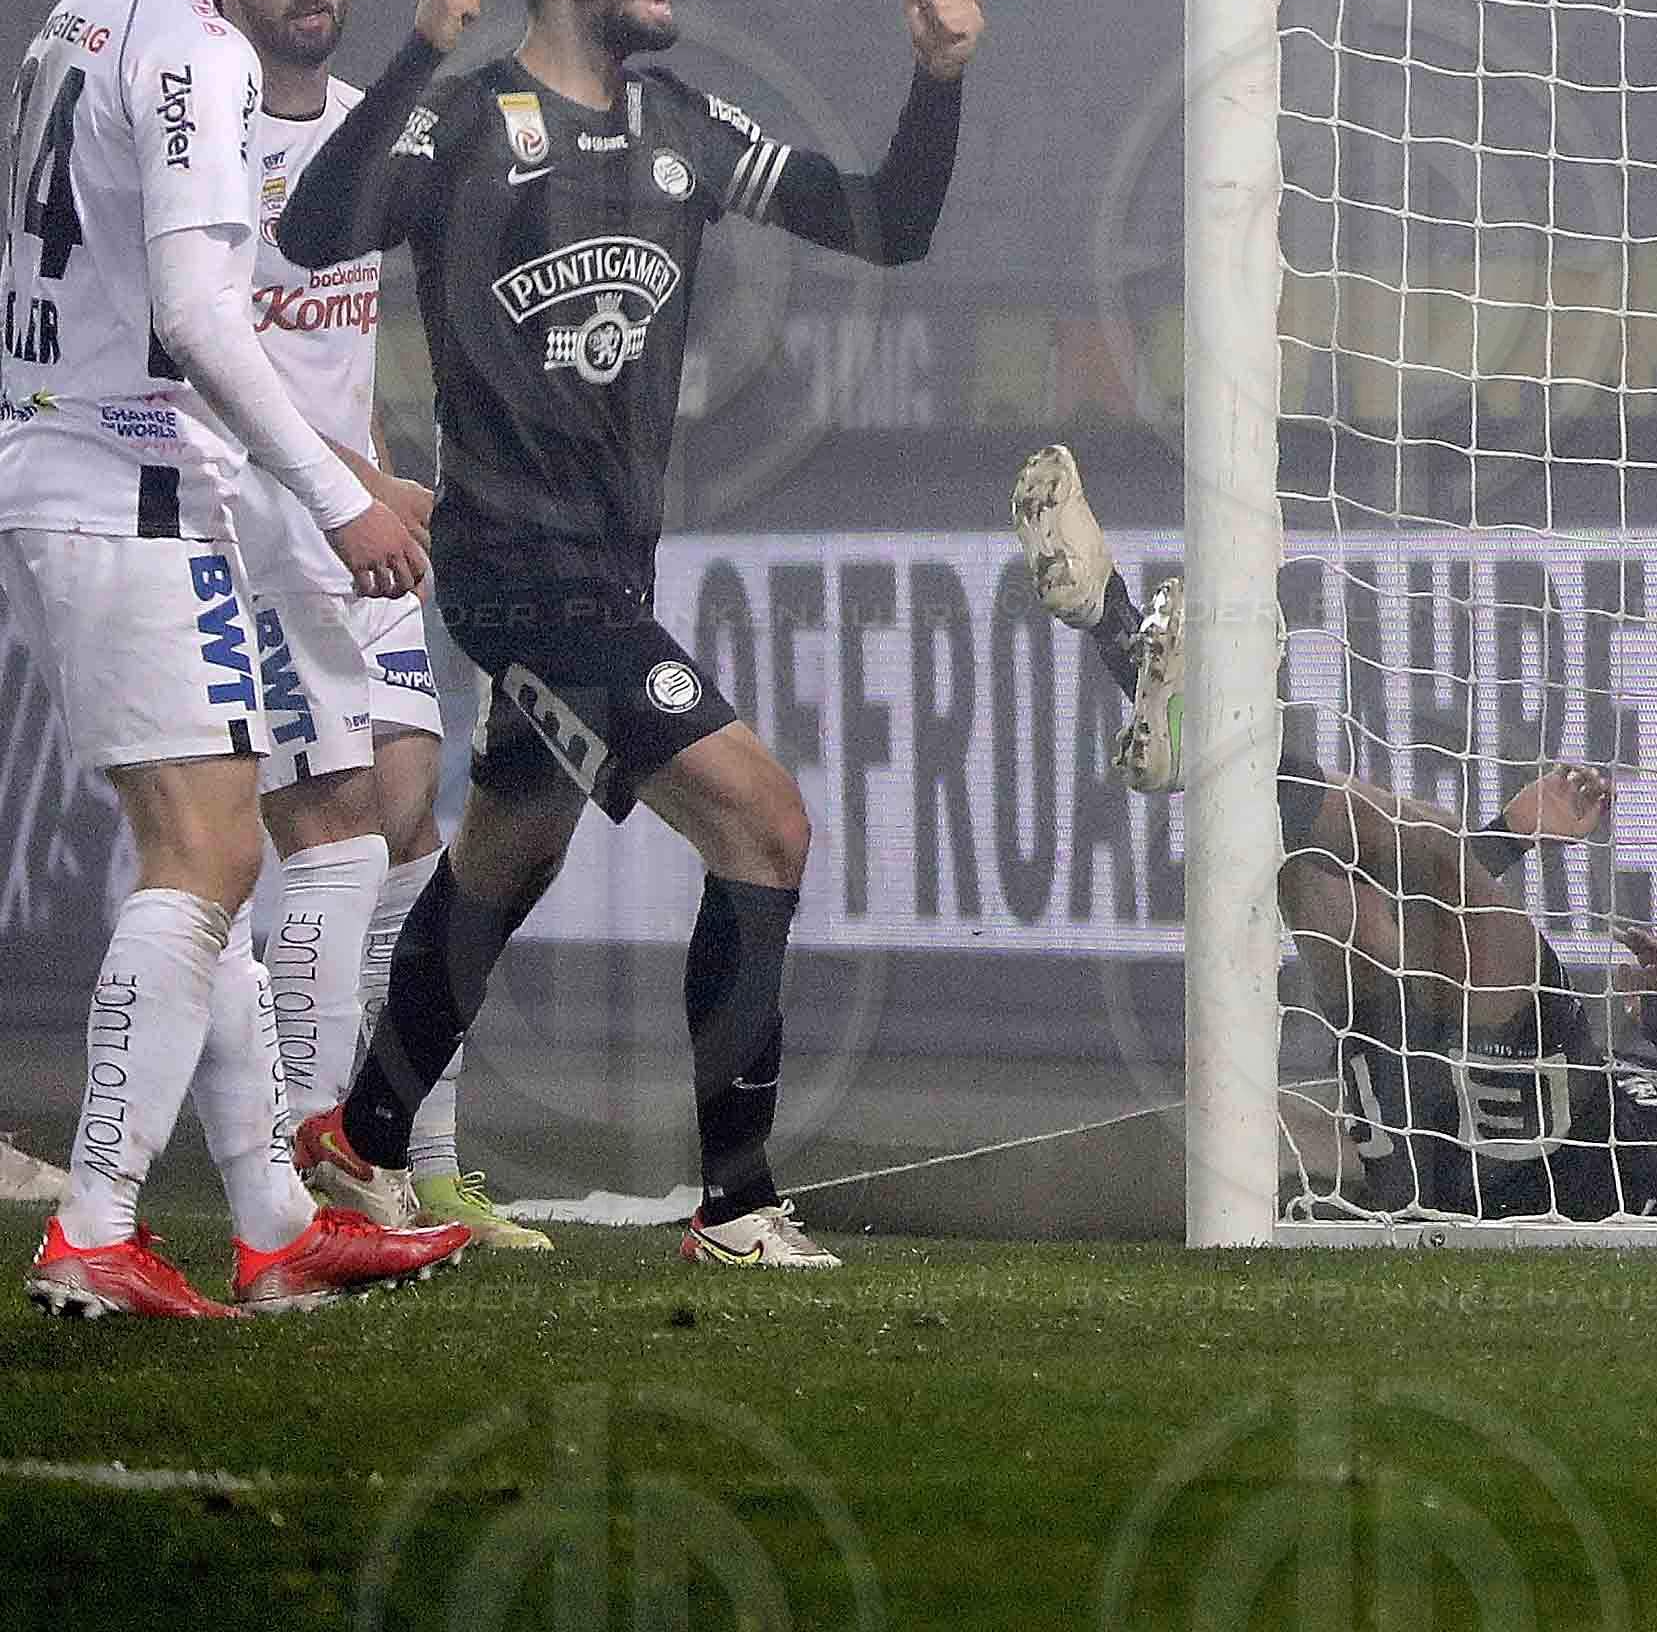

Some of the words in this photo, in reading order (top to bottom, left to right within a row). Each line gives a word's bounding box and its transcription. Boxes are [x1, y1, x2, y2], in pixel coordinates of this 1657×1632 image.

[160, 64, 192, 171] Zipfer
[508, 246, 671, 308] PUNTIGAMER
[189, 555, 257, 712] BWT
[277, 911, 324, 981] LUCE
[92, 972, 137, 1052] LUCE
[272, 990, 318, 1090] MOLTO
[83, 1061, 128, 1182] MOLTO
